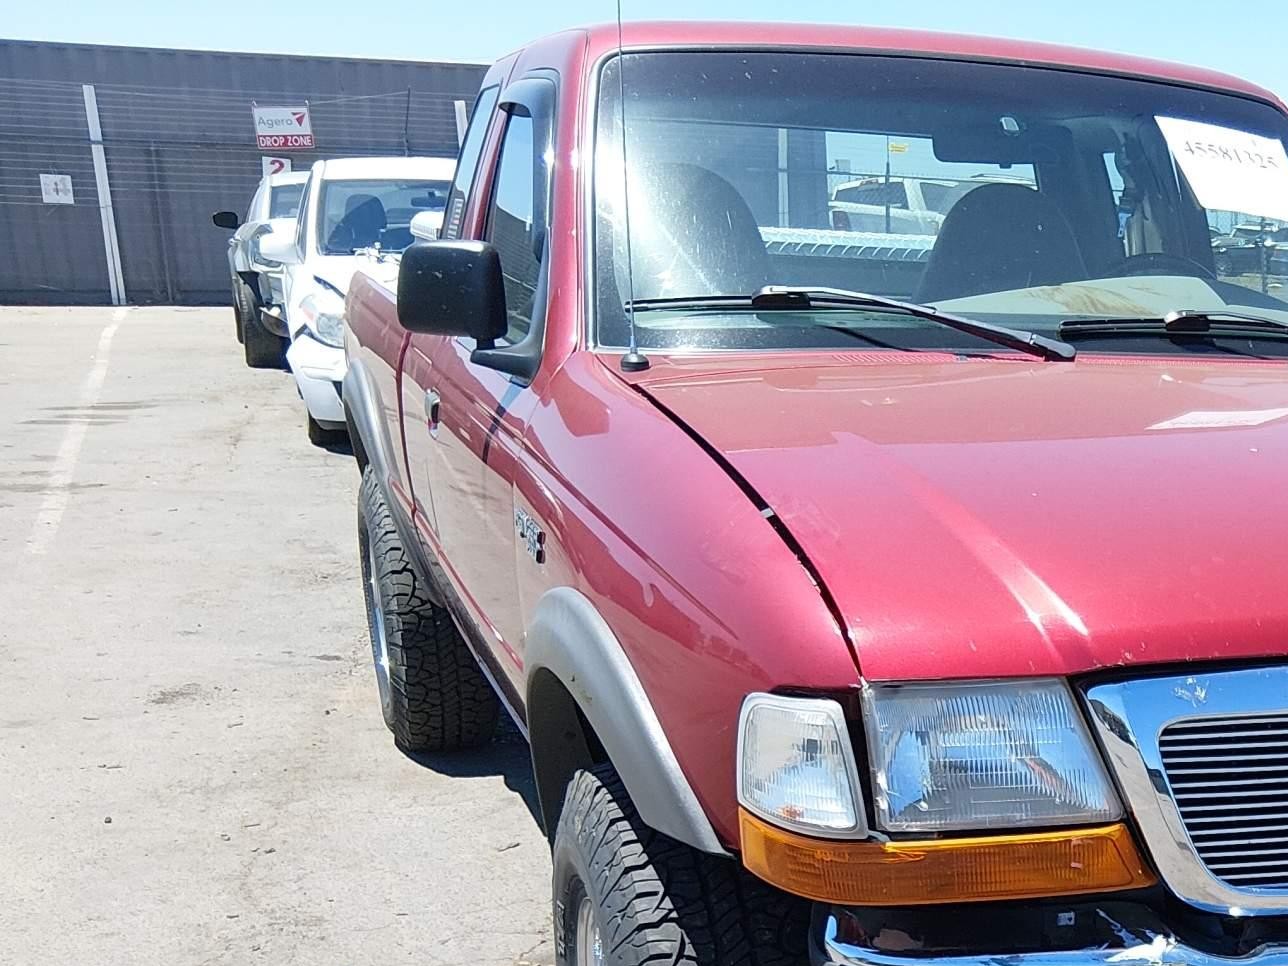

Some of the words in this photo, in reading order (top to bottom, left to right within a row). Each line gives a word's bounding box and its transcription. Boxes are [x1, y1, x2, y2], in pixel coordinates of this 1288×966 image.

[258, 116, 293, 129] Agero
[259, 135, 285, 147] DROP
[287, 135, 312, 146] ZONE
